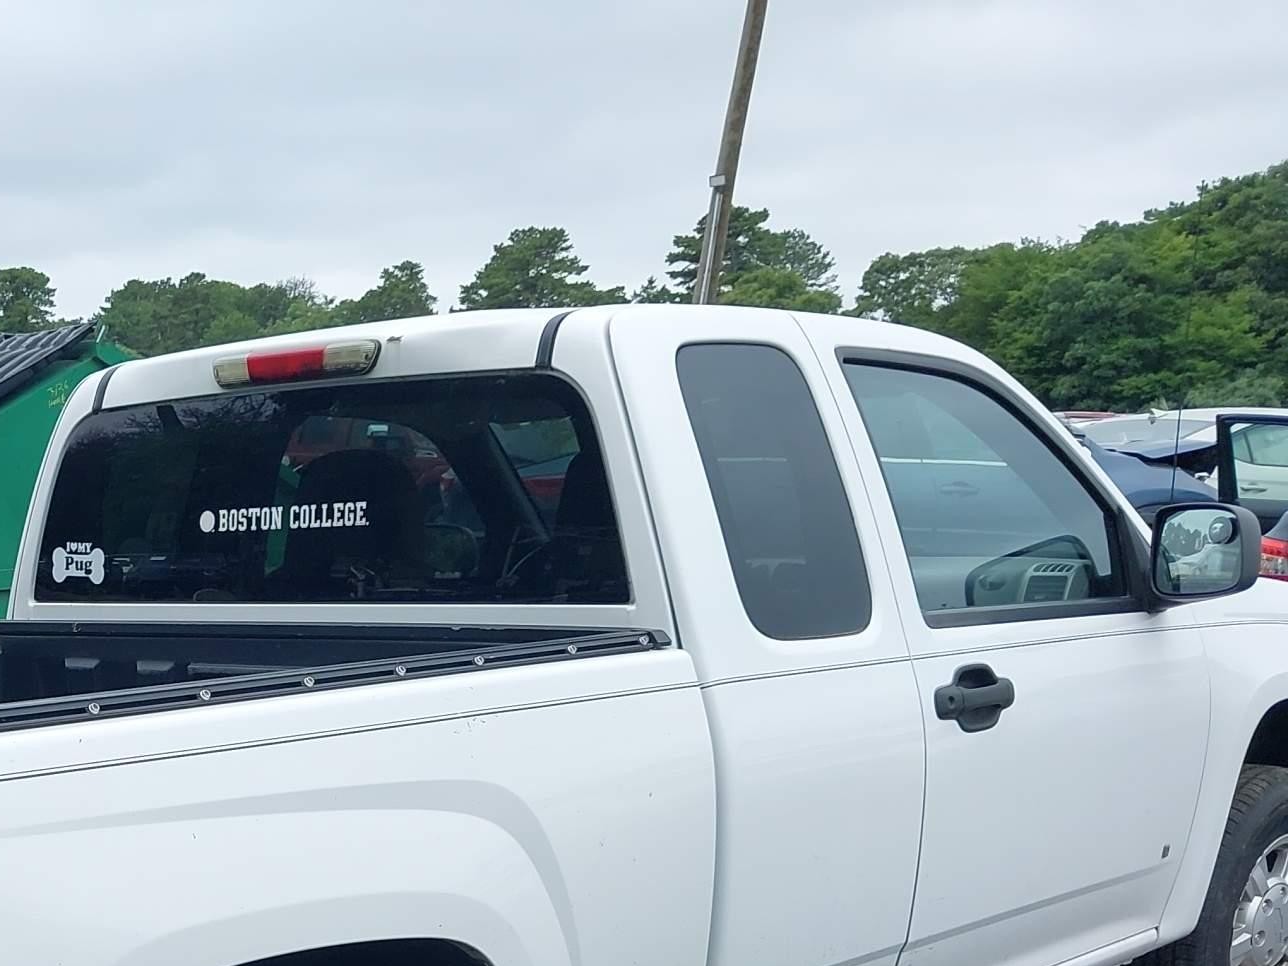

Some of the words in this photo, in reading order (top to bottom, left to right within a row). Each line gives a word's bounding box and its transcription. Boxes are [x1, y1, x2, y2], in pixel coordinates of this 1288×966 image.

[218, 506, 284, 532] BOSTON
[66, 541, 72, 553] I
[77, 542, 93, 553] MY
[64, 556, 93, 575] Pug
